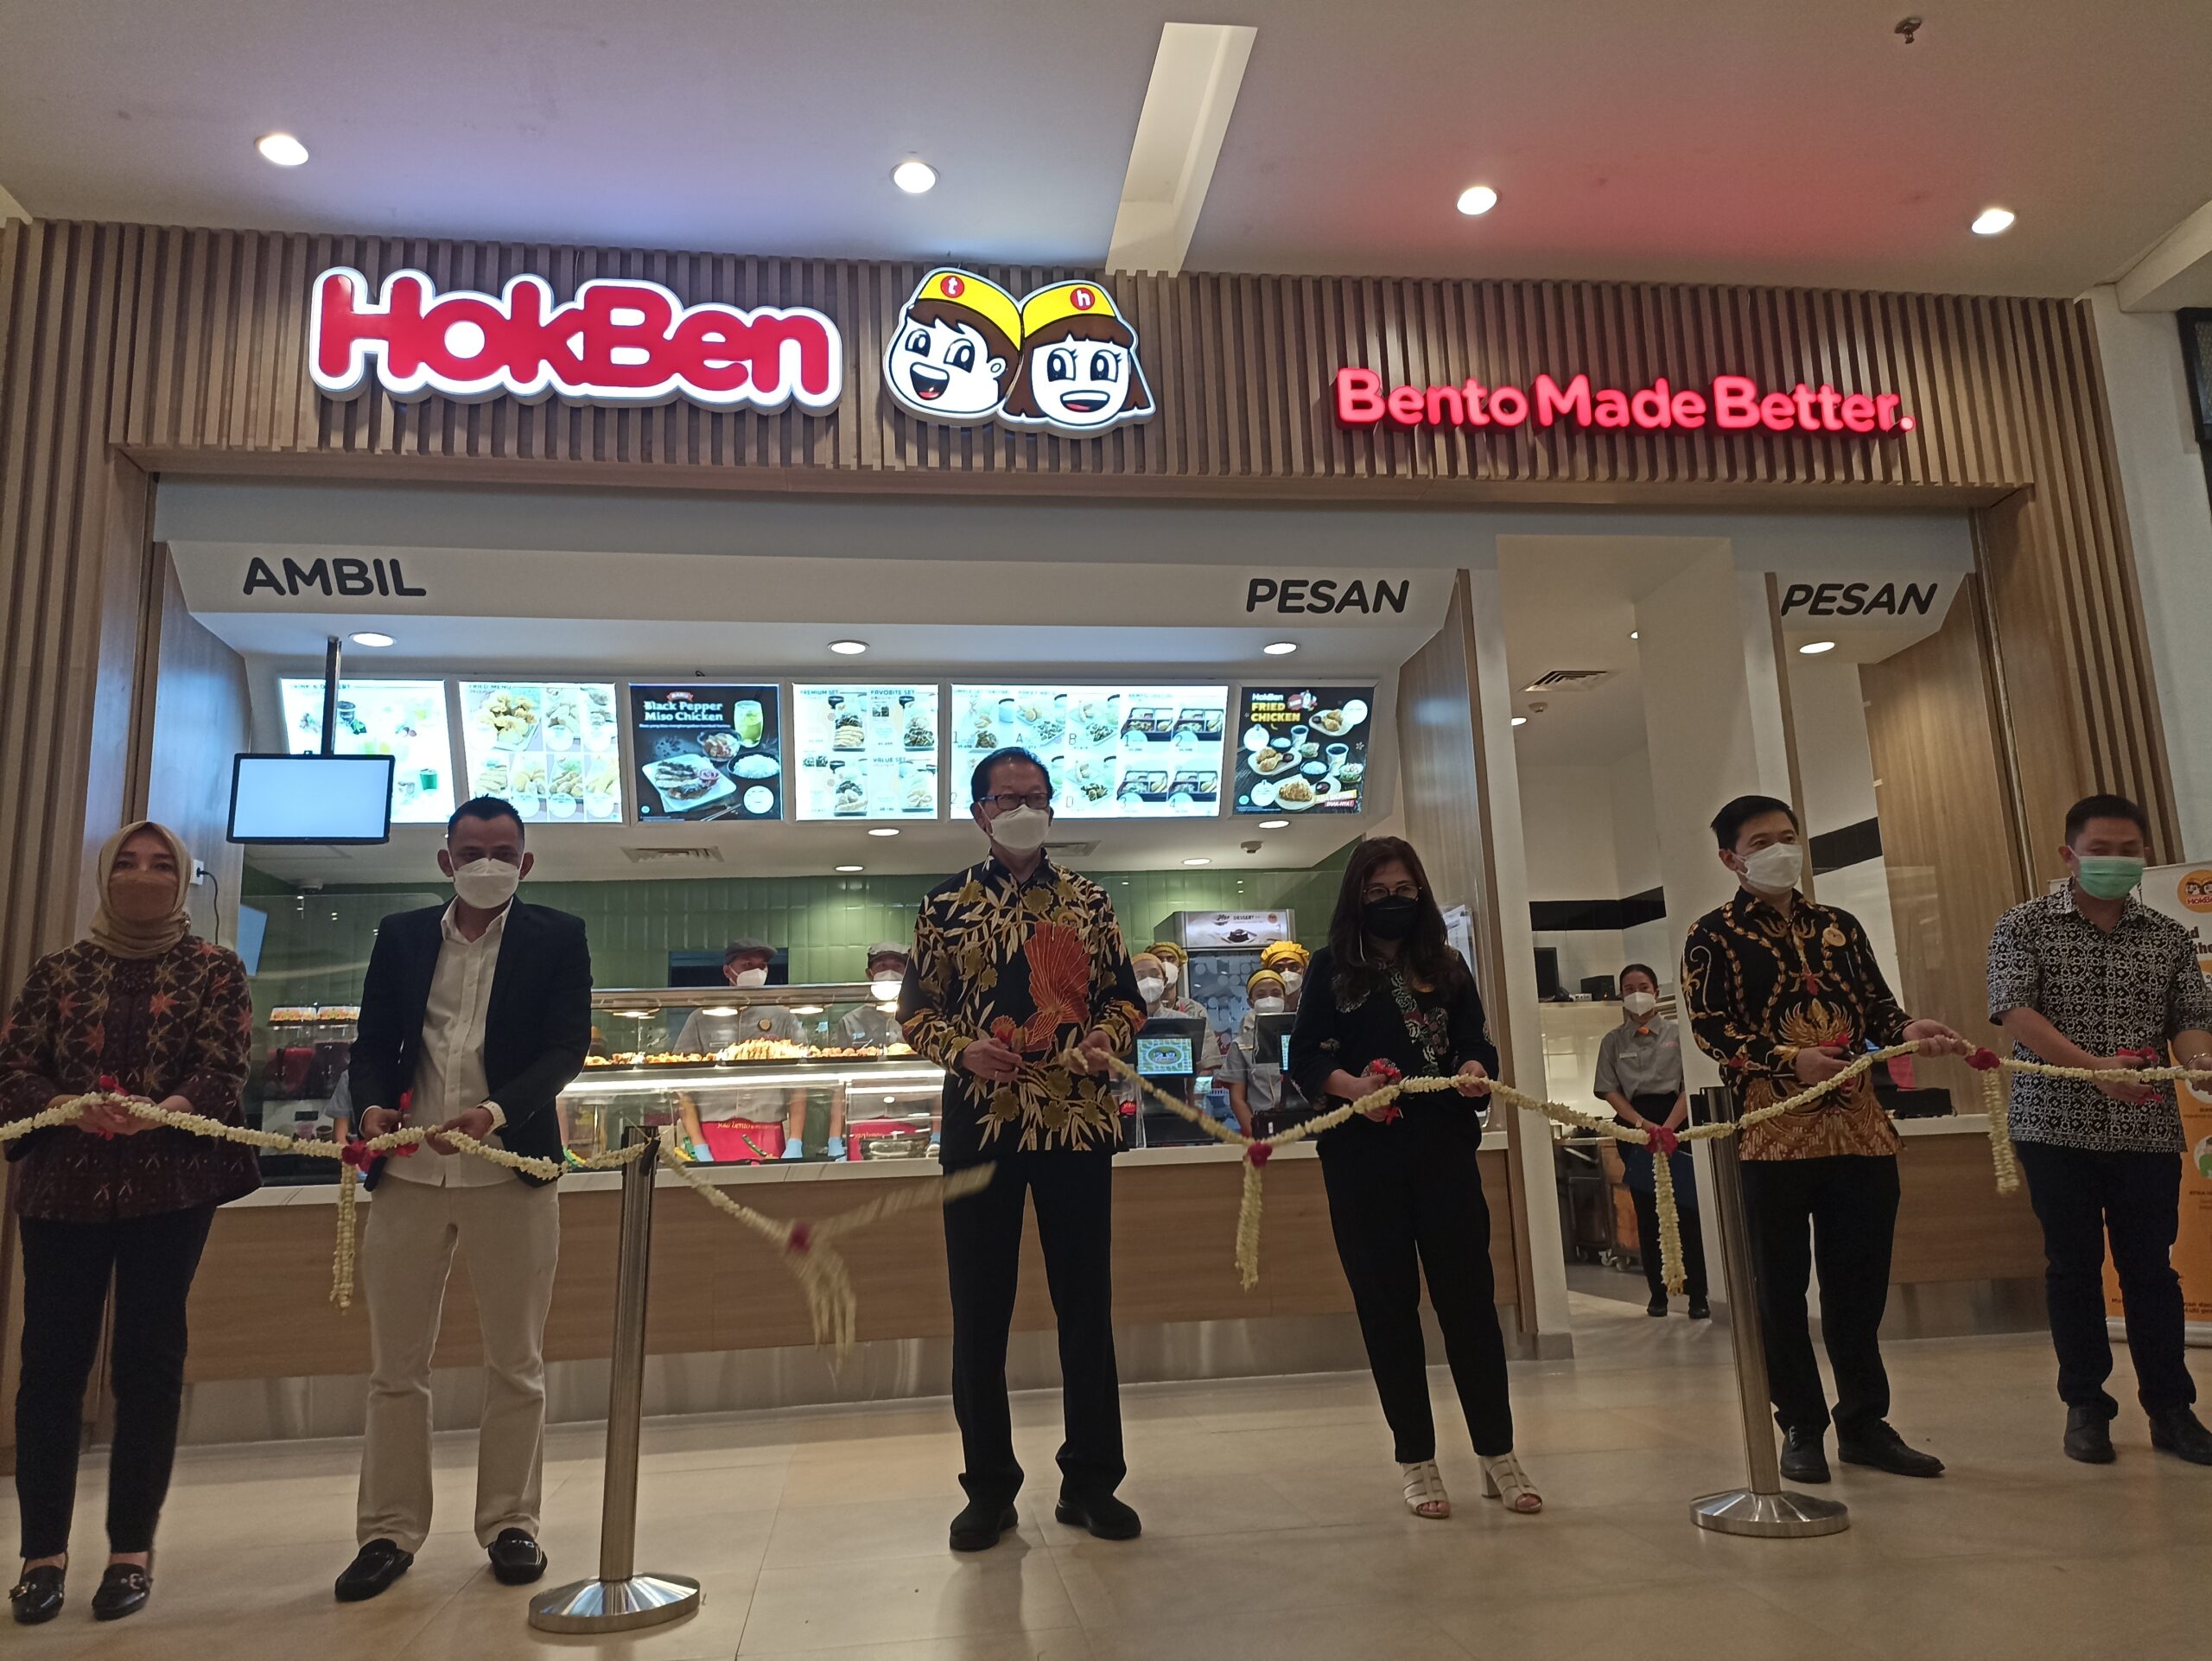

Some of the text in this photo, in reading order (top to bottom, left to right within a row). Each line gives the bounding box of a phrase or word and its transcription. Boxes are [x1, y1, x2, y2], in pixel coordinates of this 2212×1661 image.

[947, 276, 958, 296] t
[1076, 289, 1090, 307] h
[311, 269, 840, 408] HokBen
[1336, 366, 1916, 433] Bento Made Better.
[243, 557, 427, 596] AMBIL
[1246, 578, 1410, 614] PESAN
[1781, 582, 1938, 616] PESAN
[644, 701, 723, 713] Black Pepper
[645, 711, 723, 721] Miso Chicken
[1251, 702, 1286, 711] FRIED
[1250, 712, 1300, 722] CHICKEN
